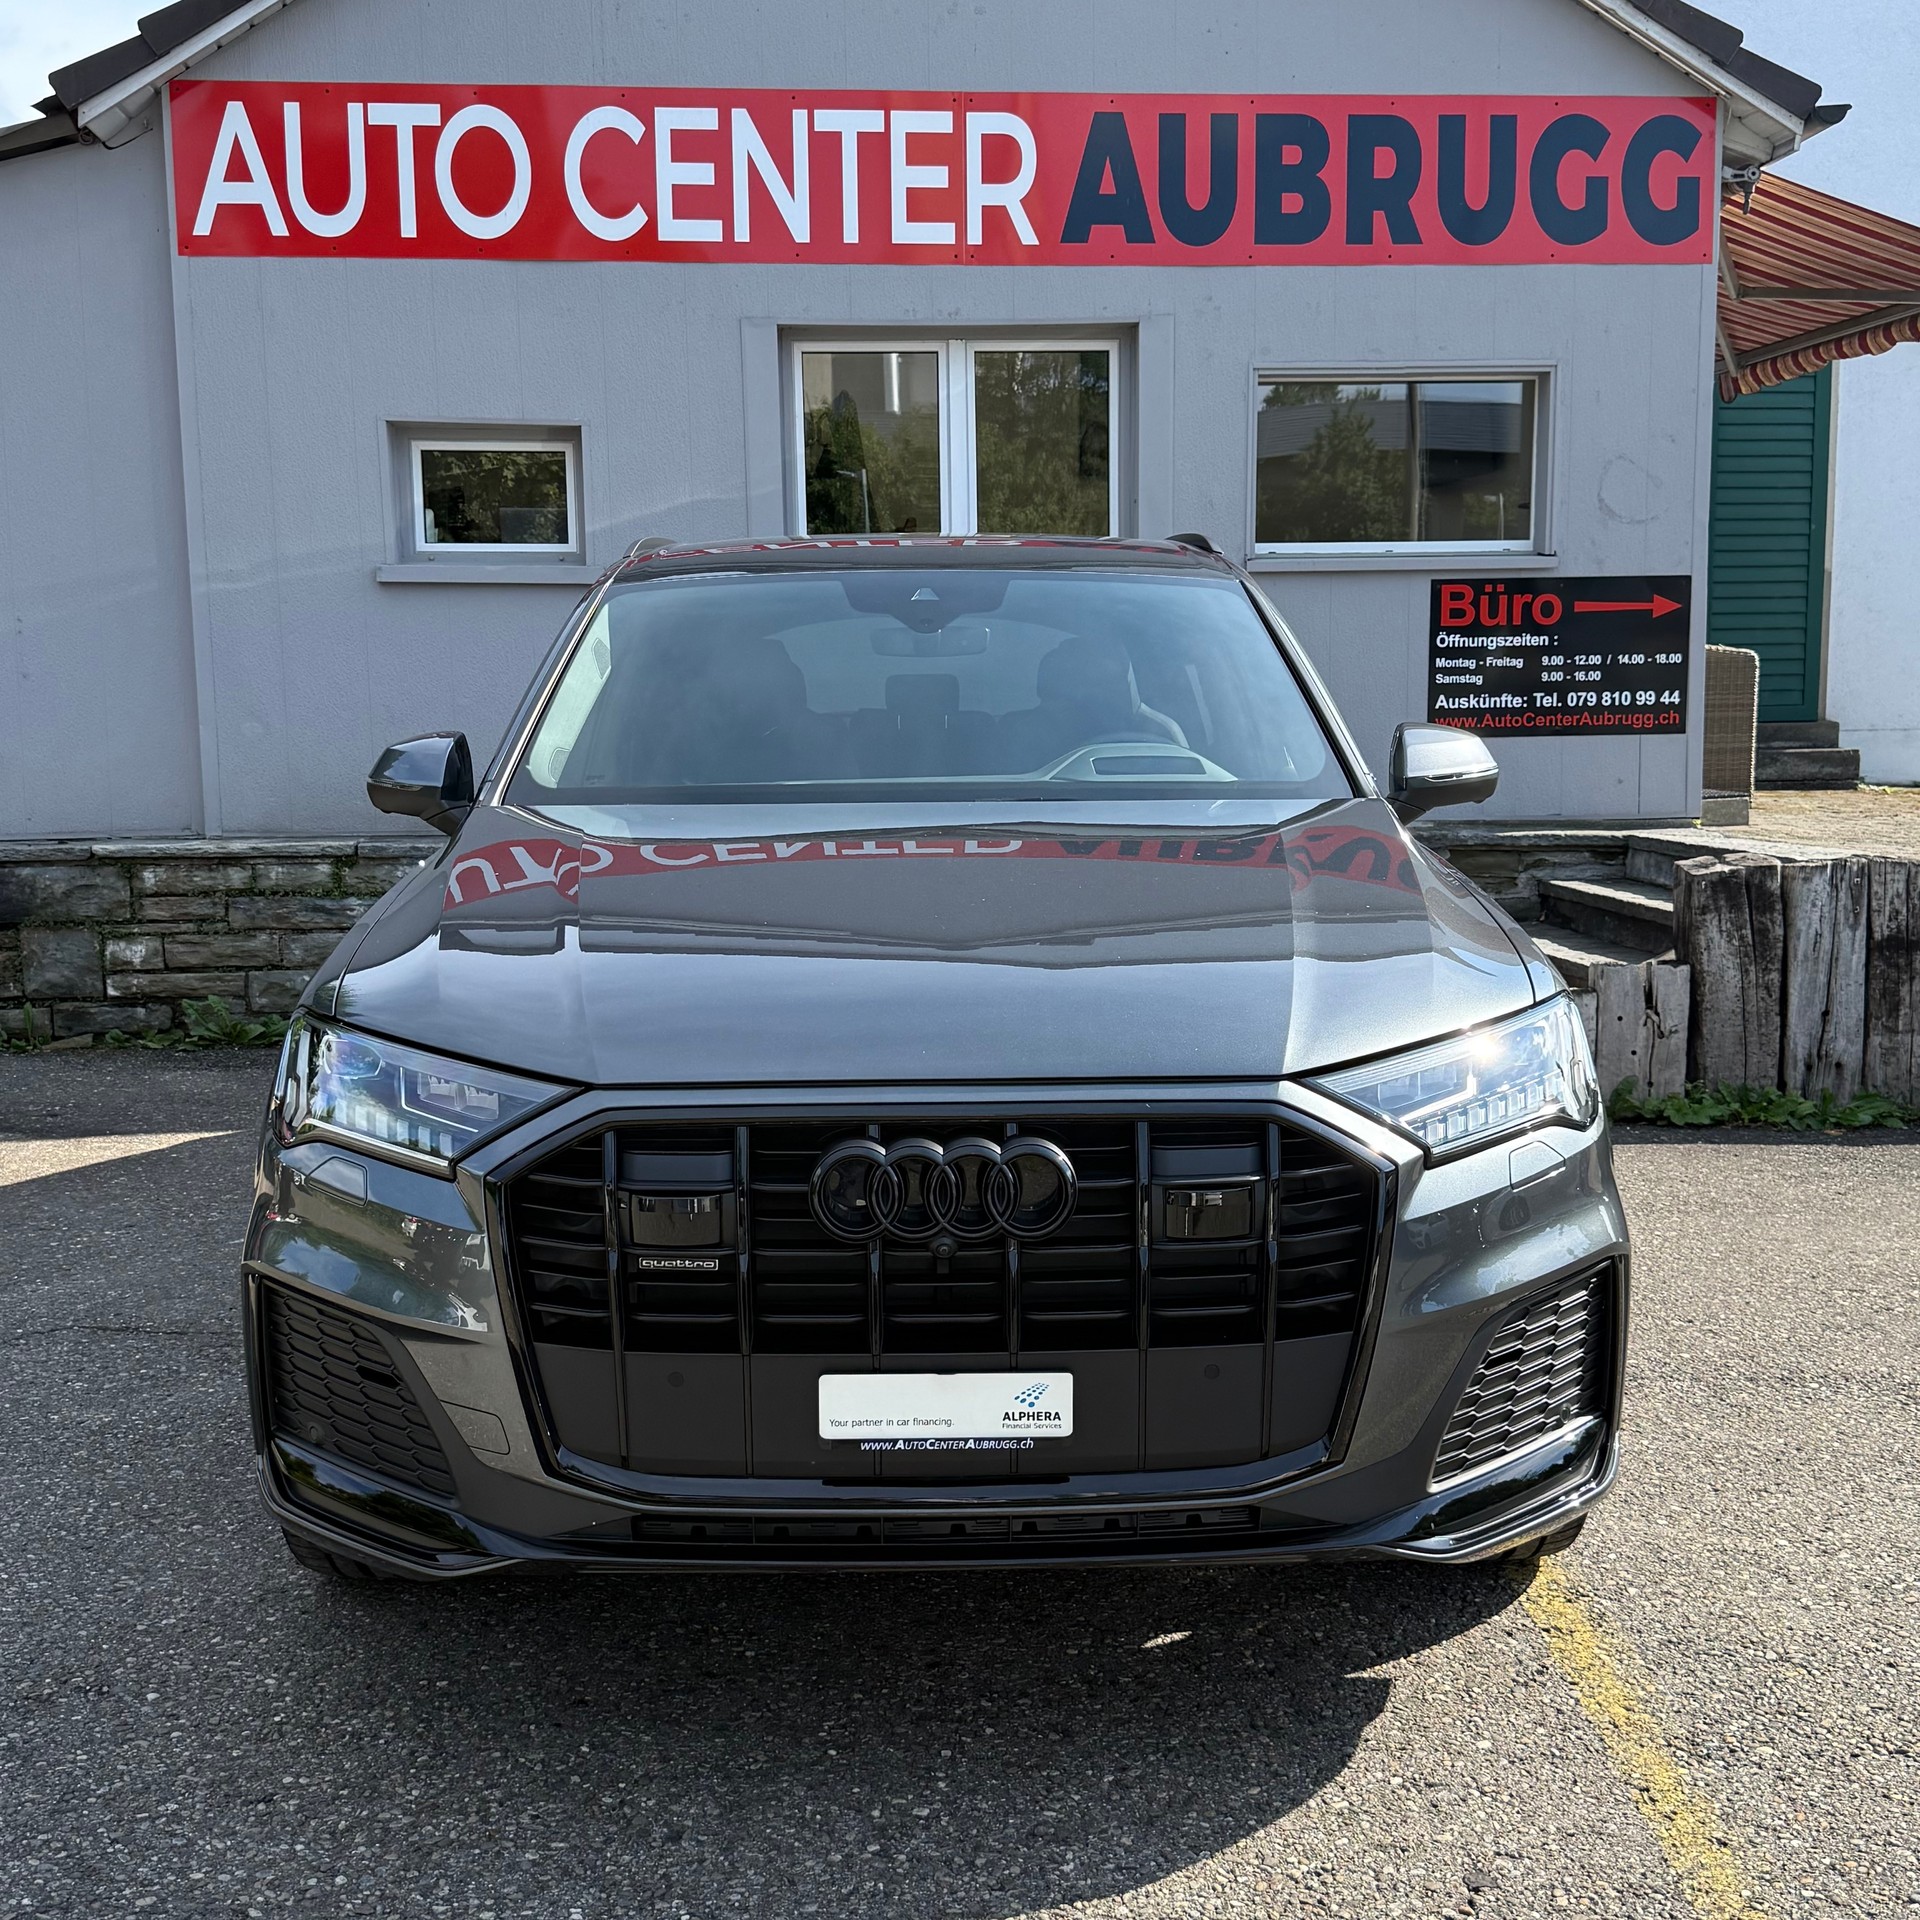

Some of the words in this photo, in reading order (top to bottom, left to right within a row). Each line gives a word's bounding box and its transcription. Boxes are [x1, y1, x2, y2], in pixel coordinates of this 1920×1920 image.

[192, 101, 532, 239] AUTO
[563, 105, 1039, 247] CENTER
[1060, 111, 1703, 246] AUBRUGG
[1440, 584, 1562, 627] Büro
[1436, 632, 1549, 649] Öffnungszeiten
[1436, 658, 1476, 669] Montag
[1486, 657, 1523, 668] Freitag
[1541, 655, 1564, 666] 9.00
[1574, 655, 1601, 665] 12.00
[1618, 654, 1645, 665] 14.00
[1655, 653, 1682, 664] 18.00
[1436, 673, 1483, 685] Samstag
[1541, 671, 1563, 682] 9.00
[1574, 671, 1601, 681] 16.00
[1435, 693, 1528, 709] Auskünfte:
[1533, 693, 1562, 707] Tel.
[1567, 692, 1596, 706] 079
[1602, 691, 1631, 706] 810
[1636, 691, 1655, 705] 99
[1660, 690, 1680, 704] 44
[1435, 710, 1679, 728] www.AutoCenterAubrugg.ch
[642, 1259, 716, 1269] quattro
[830, 1419, 848, 1427] Your
[851, 1419, 883, 1428] partner
[913, 1418, 954, 1428] financing.
[1003, 1411, 1061, 1421] ALPHERA
